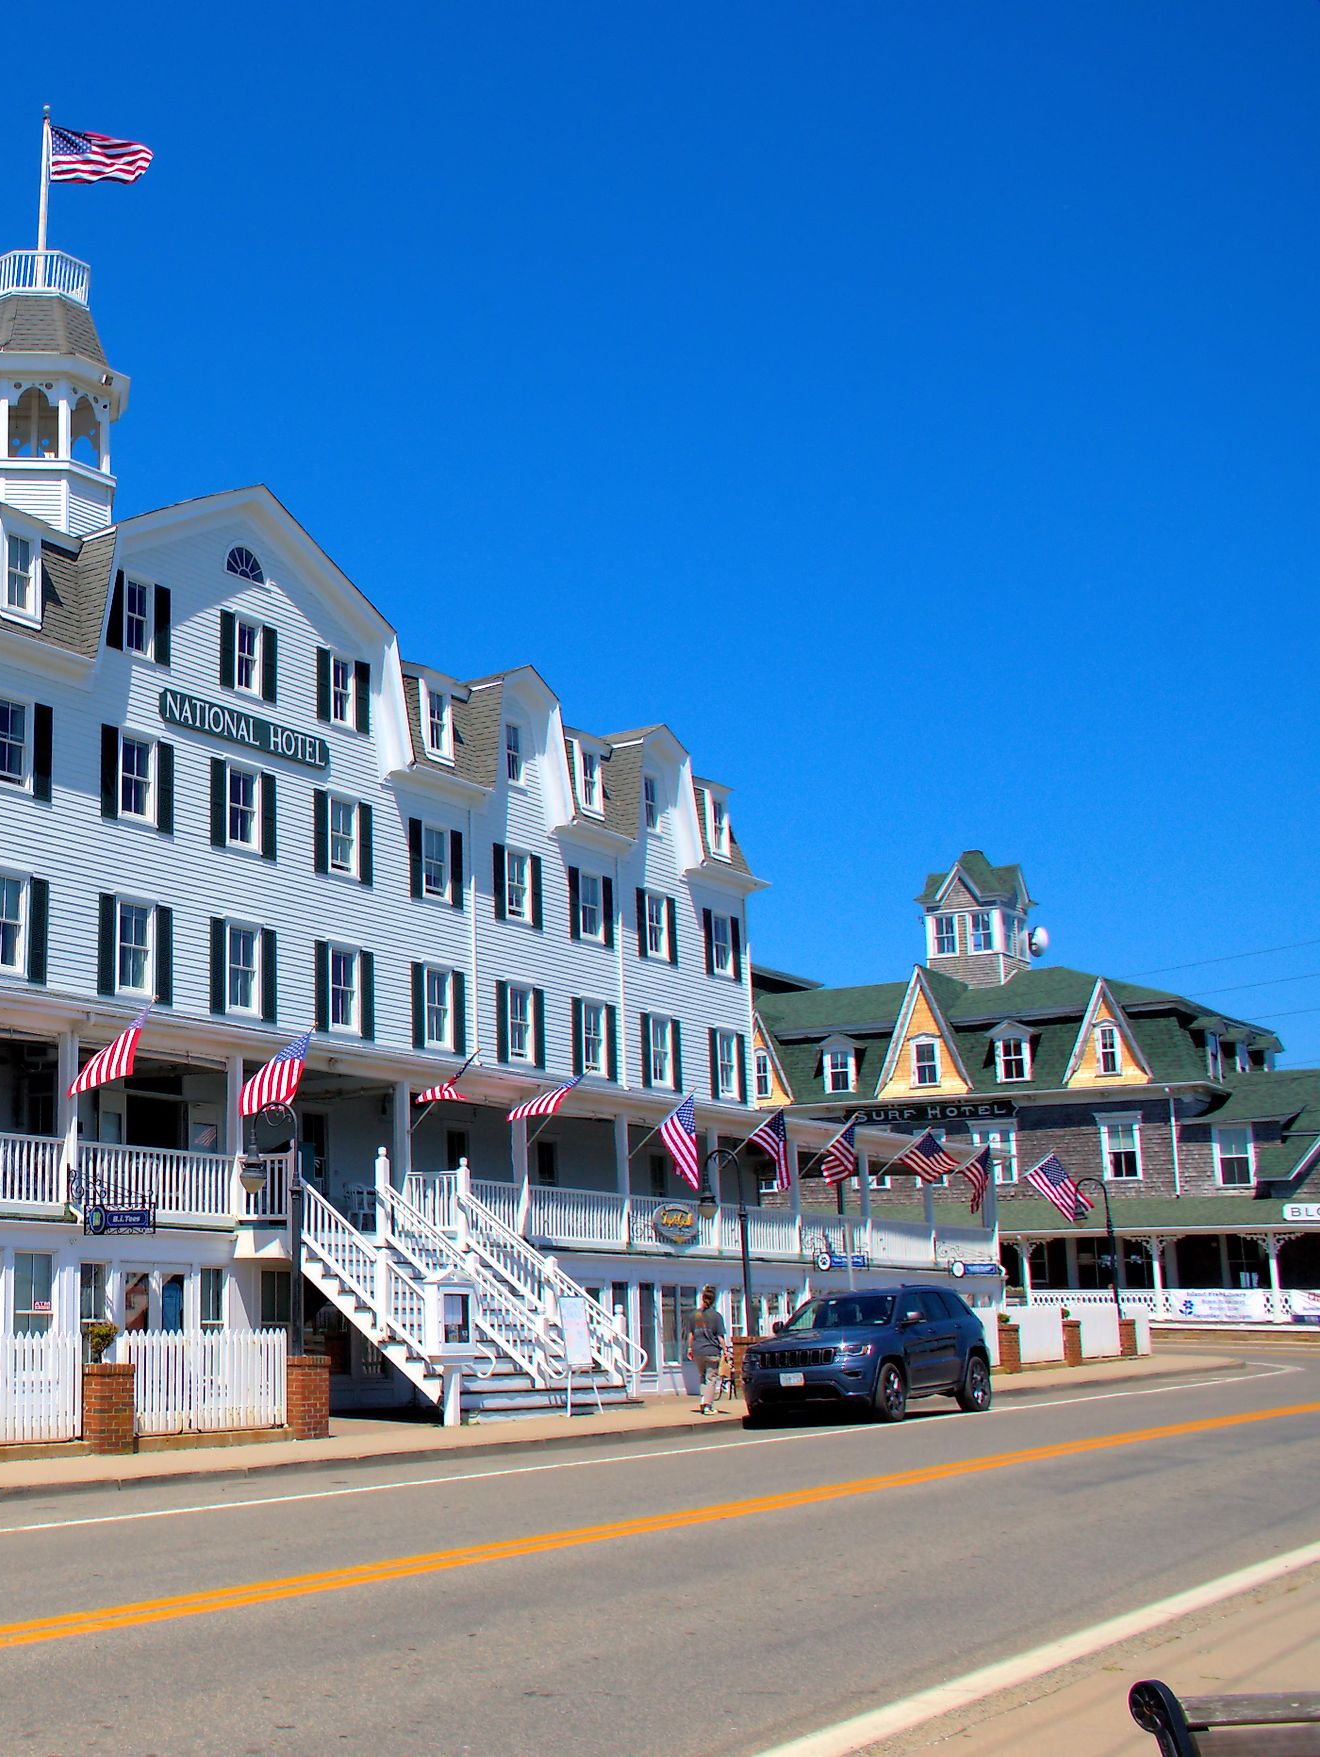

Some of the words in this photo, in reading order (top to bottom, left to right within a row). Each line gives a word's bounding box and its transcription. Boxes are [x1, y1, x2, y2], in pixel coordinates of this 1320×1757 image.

[165, 691, 260, 746] NATIONAL
[268, 724, 326, 767] HOTEL
[855, 1109, 917, 1123] SURF
[927, 1104, 1007, 1119] HOTEL
